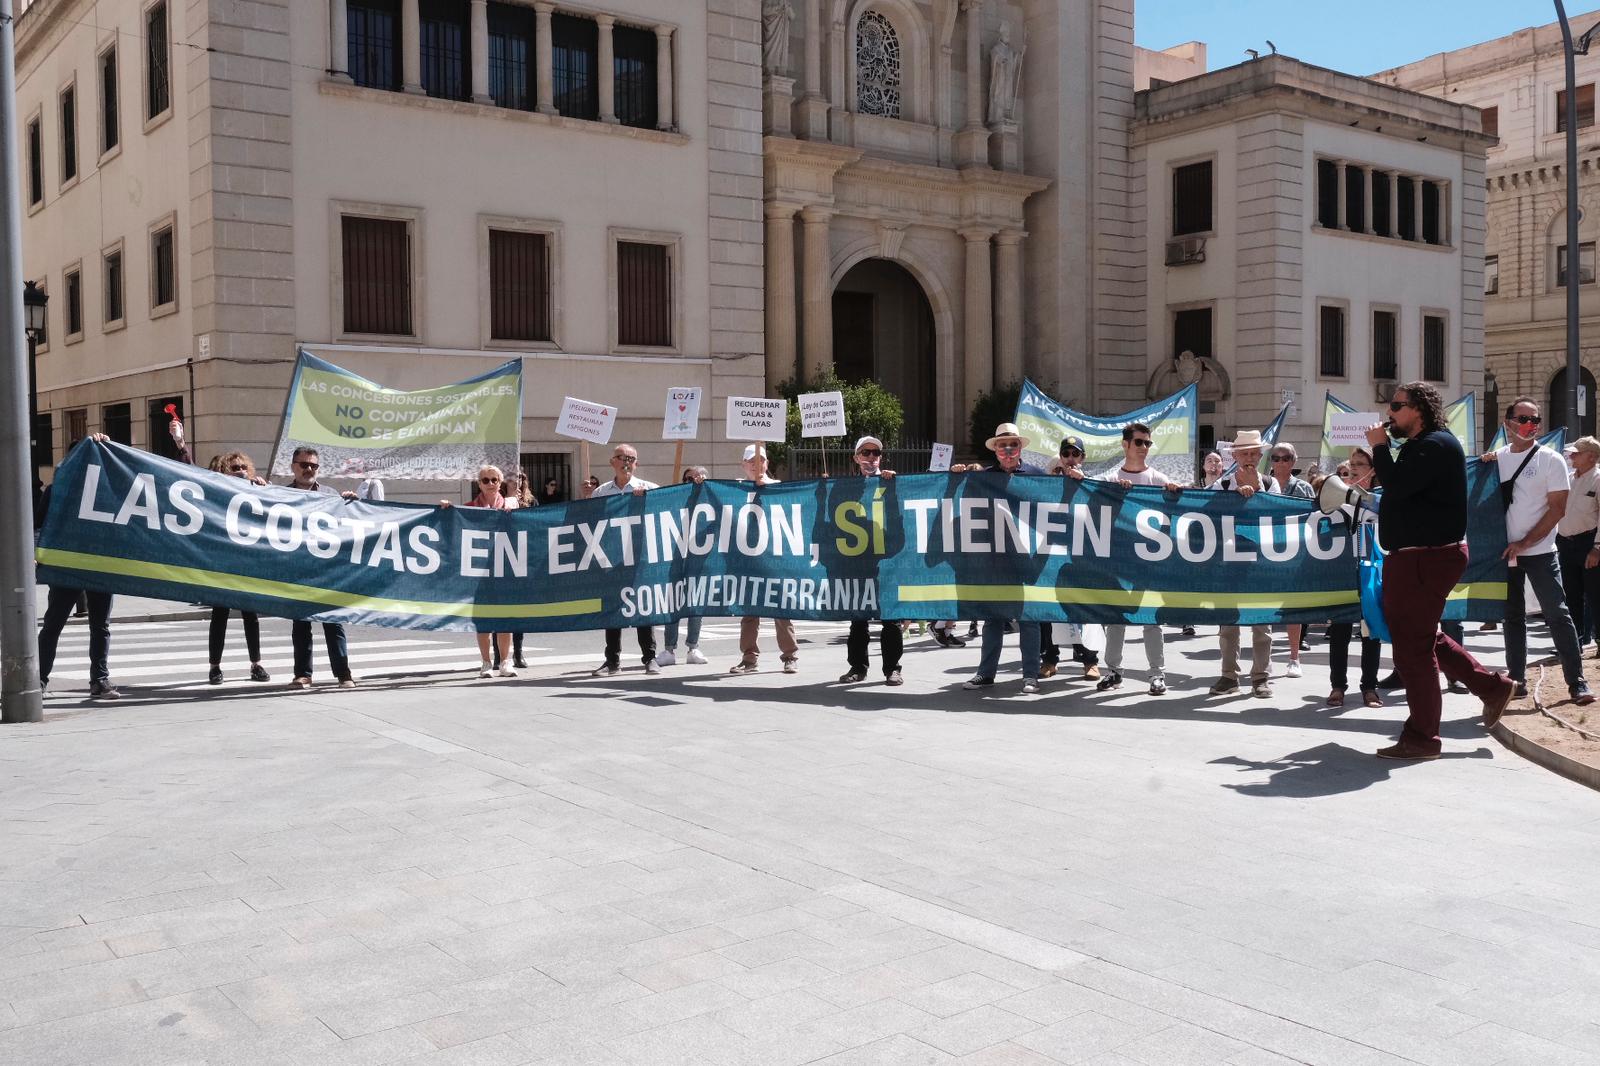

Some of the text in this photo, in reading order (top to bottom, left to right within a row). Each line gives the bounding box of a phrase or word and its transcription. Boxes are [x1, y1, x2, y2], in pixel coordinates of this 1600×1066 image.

[302, 379, 327, 393] LAS
[330, 385, 432, 405] CONCESIONES
[734, 400, 780, 409] RECUPERAR
[819, 400, 838, 408] Costas
[335, 402, 482, 422] NO CONTAMINAN,
[740, 410, 766, 418] CALAS
[804, 412, 816, 420] para
[822, 410, 837, 419] gente
[568, 413, 604, 426] RESTAURAR
[742, 419, 771, 428] PLAYAS
[338, 421, 476, 440] NO SE ELIMINAN
[566, 424, 600, 436] ESPIGONES
[1021, 421, 1060, 438] SOMOS
[78, 463, 206, 536] LAS
[225, 493, 441, 575] COSTAS
[460, 528, 528, 578] EN
[548, 492, 819, 575] EXTINCIÓN,
[834, 487, 887, 557] SÍ
[903, 497, 1113, 558] TIENEN
